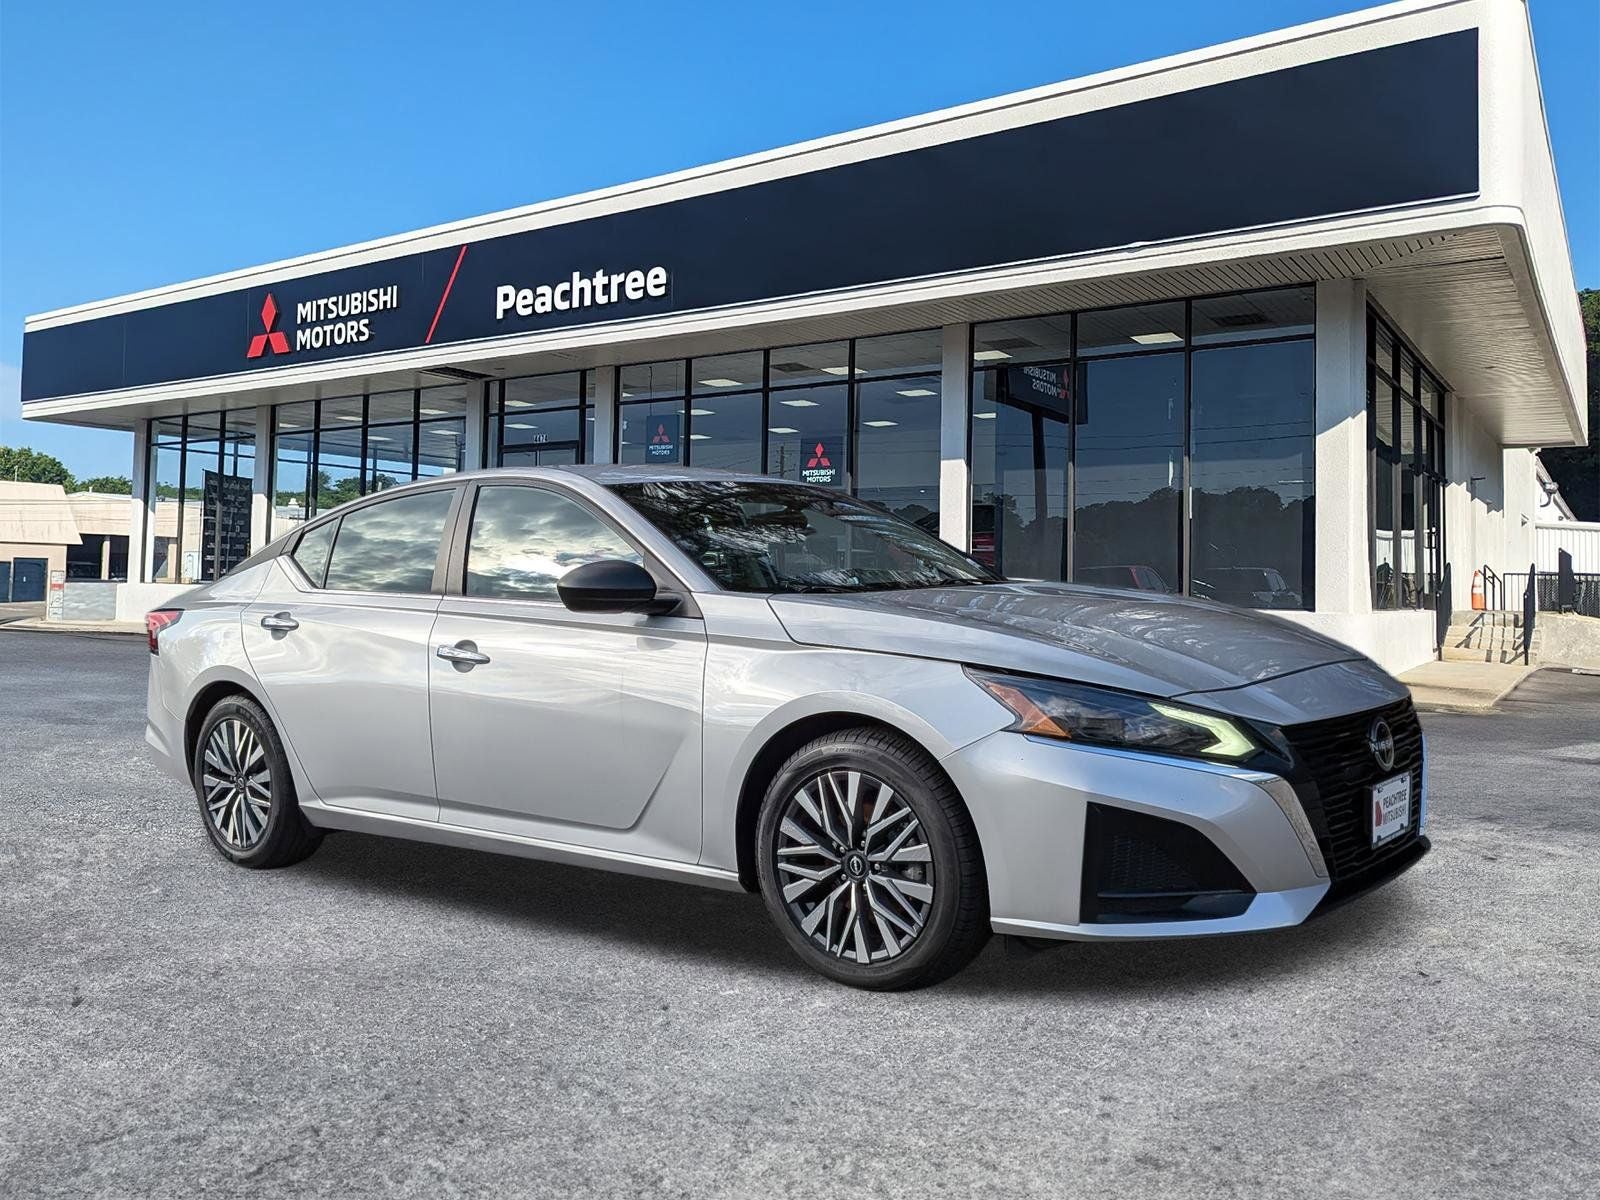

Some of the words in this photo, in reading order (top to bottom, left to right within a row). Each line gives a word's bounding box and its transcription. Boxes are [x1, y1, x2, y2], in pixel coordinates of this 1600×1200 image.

[296, 285, 398, 324] MITSUBISHI
[495, 266, 668, 320] Peachtree
[296, 318, 370, 351] MOTORS
[1383, 789, 1407, 808] PEACHTREE
[1383, 803, 1407, 825] MITSUBISHI
